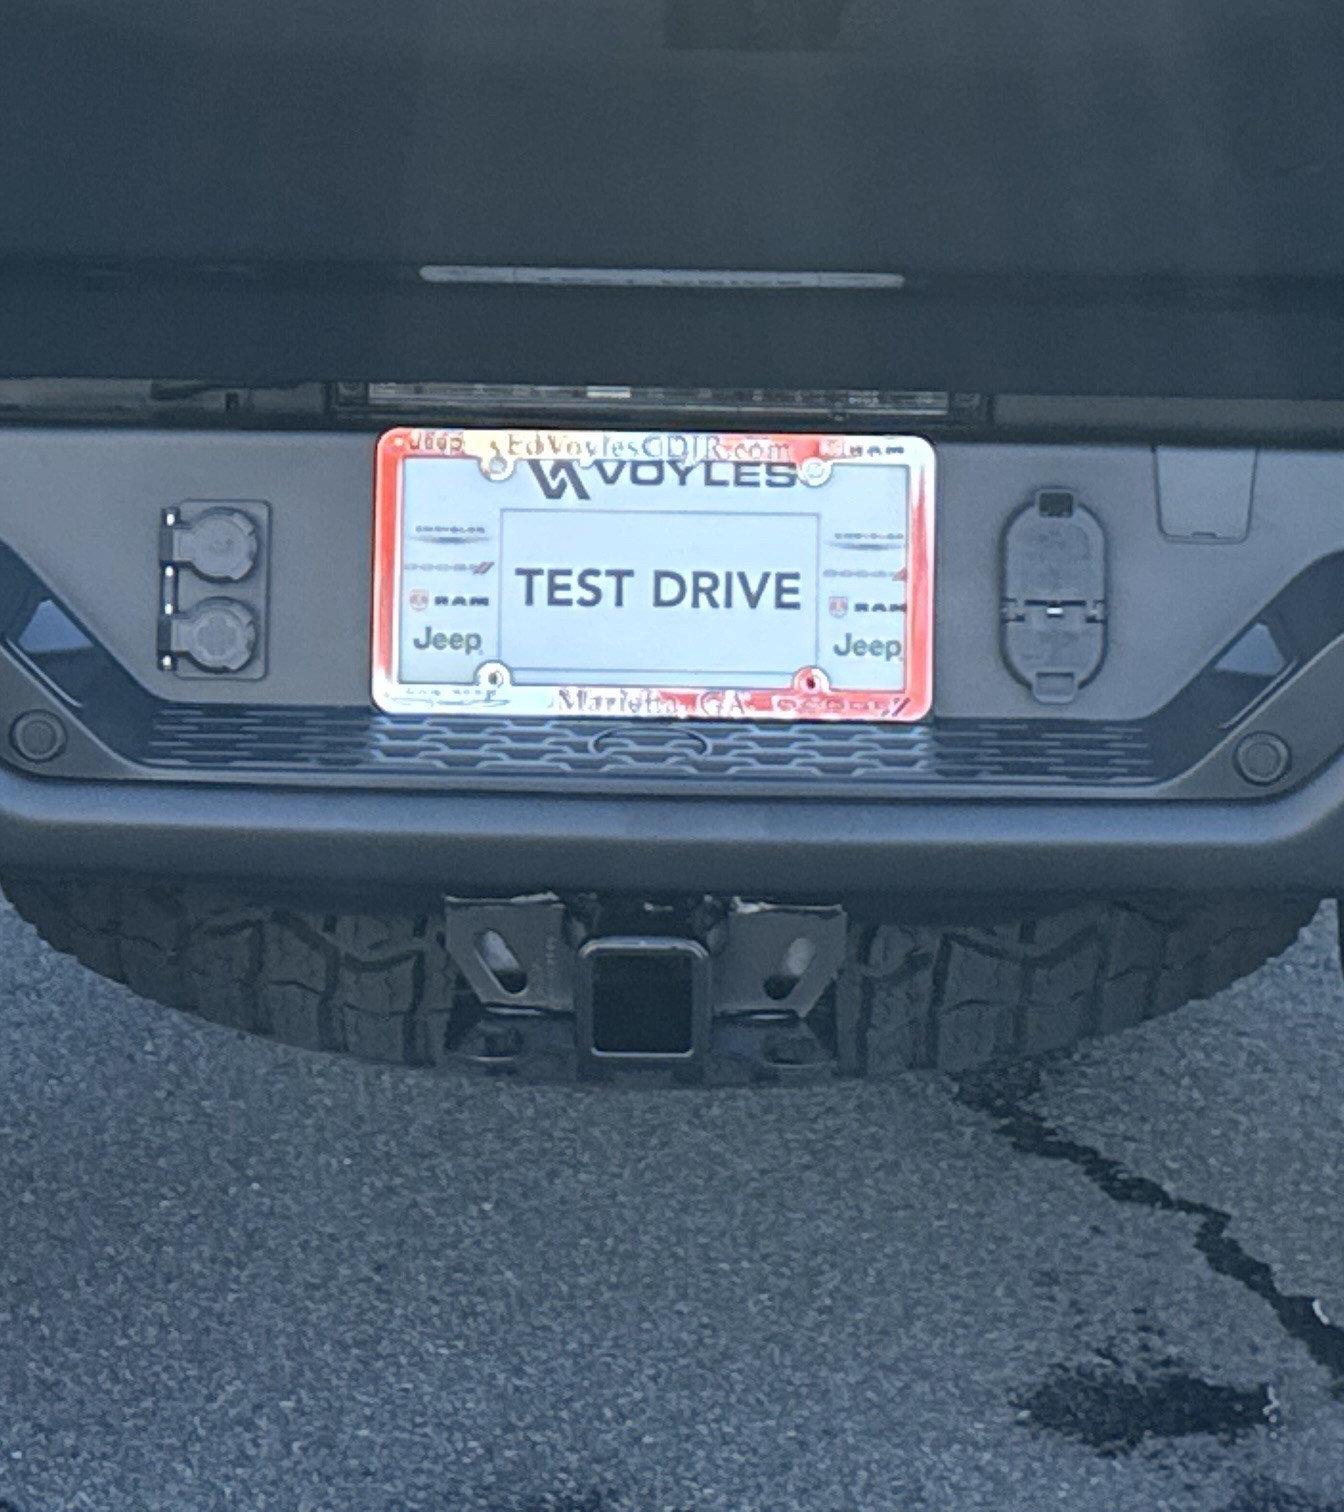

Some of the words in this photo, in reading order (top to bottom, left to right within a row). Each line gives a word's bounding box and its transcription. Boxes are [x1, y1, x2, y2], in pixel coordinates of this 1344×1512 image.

[596, 459, 797, 488] VOYLES
[514, 568, 635, 608] TEST
[652, 569, 802, 610] DRIVE
[412, 626, 483, 656] Jeep
[833, 632, 903, 662] Jeep
